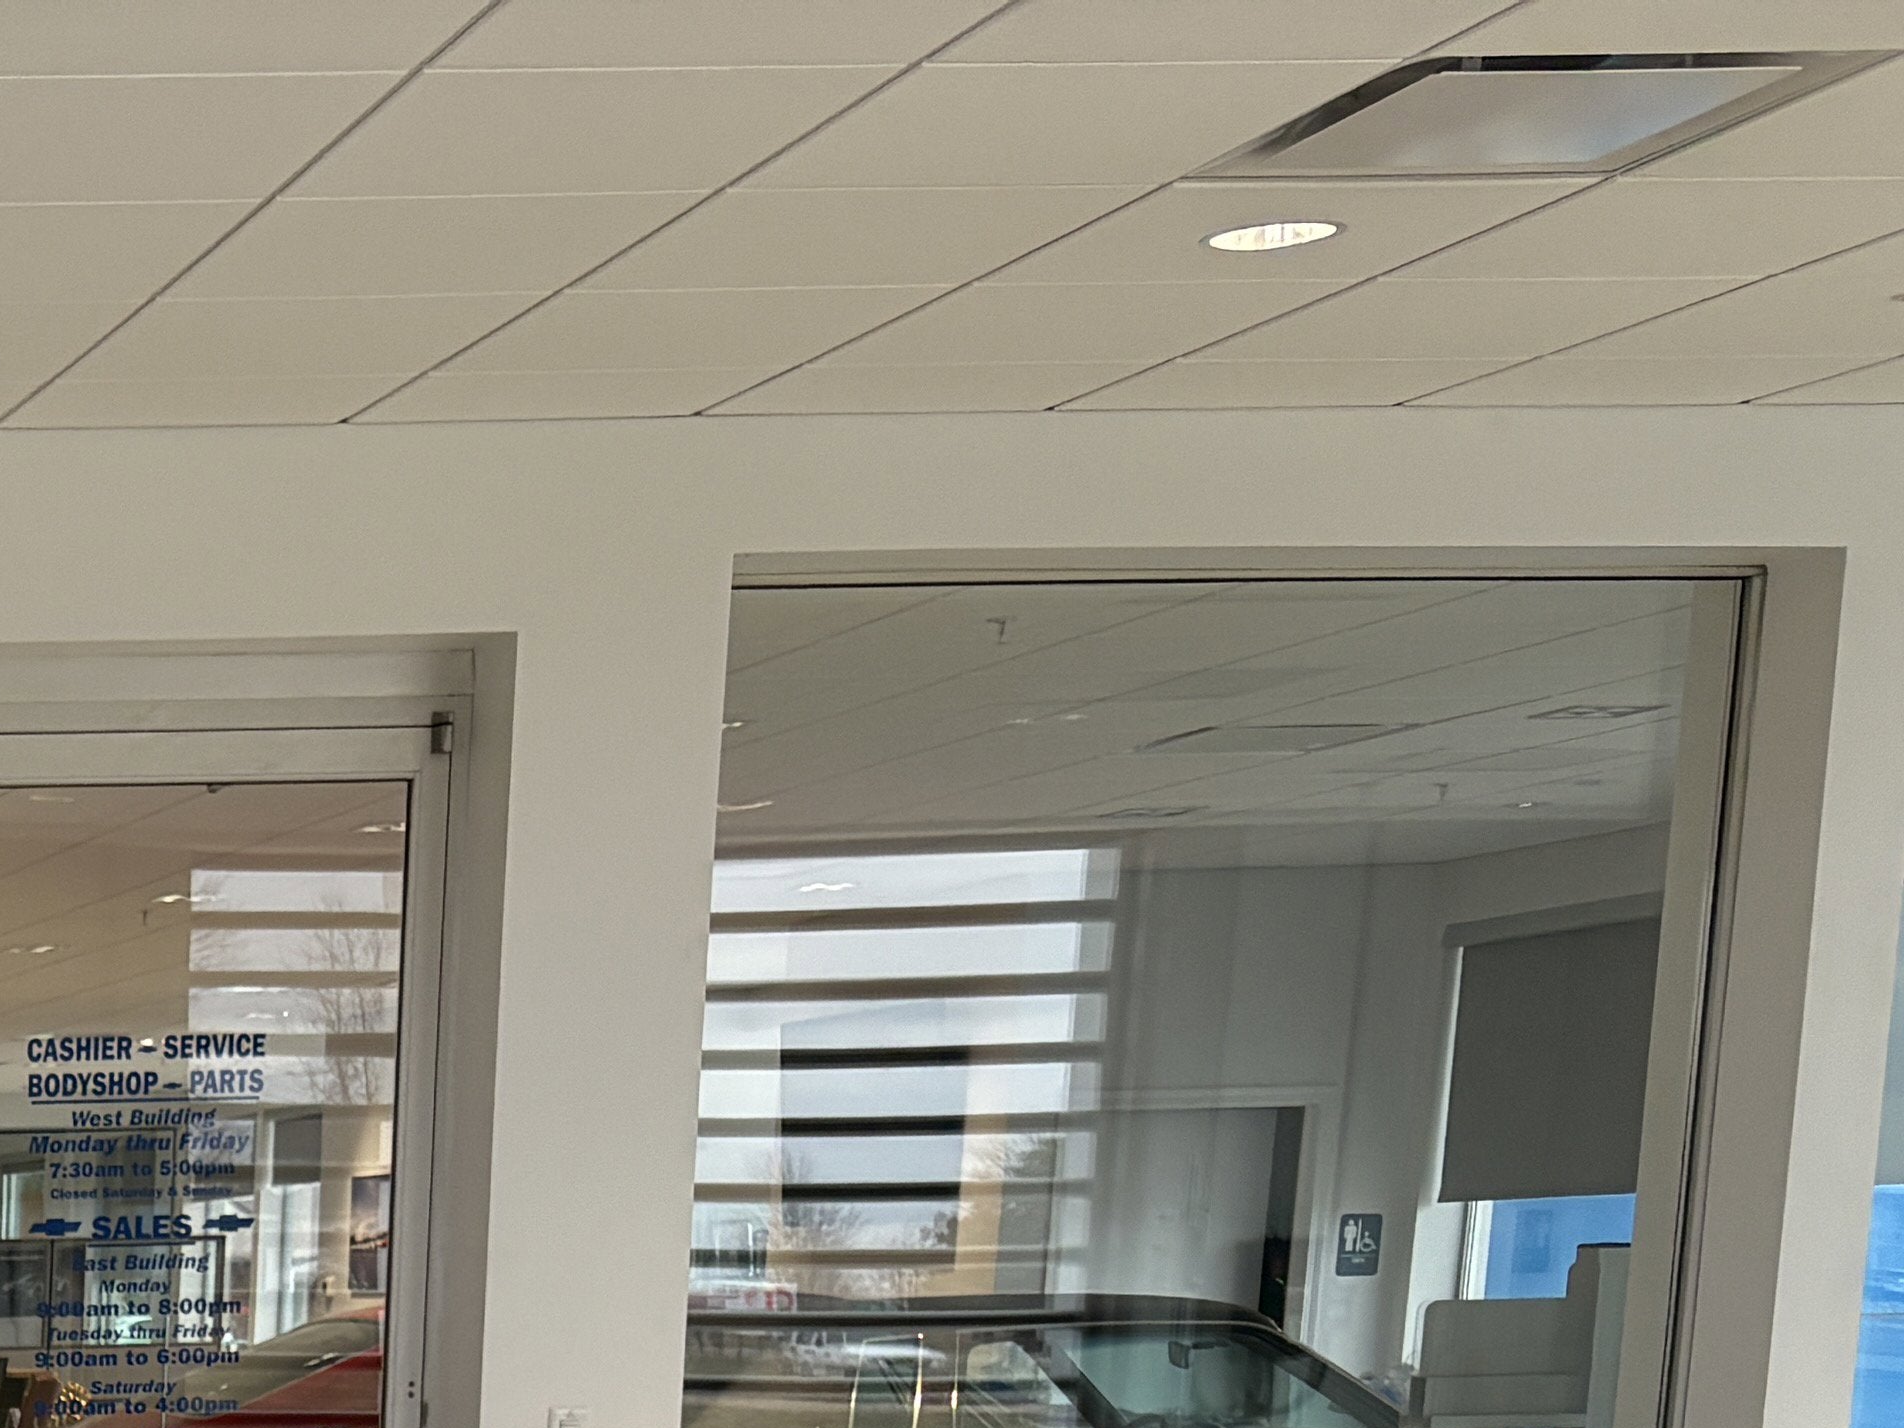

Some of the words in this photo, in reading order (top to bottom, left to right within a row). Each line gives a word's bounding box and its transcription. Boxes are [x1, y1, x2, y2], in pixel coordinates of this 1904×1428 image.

[27, 1036, 132, 1062] CASHIER
[163, 1034, 266, 1060] SERVICE
[28, 1071, 158, 1097] BODYSHOP
[190, 1069, 264, 1094] PARTS
[72, 1110, 122, 1127] West
[130, 1108, 217, 1128] Building
[29, 1136, 118, 1155] Monday
[126, 1134, 171, 1150] thru
[179, 1132, 249, 1153] Friday
[49, 1162, 124, 1179] 7:30am
[132, 1161, 152, 1176] to
[160, 1159, 235, 1178] 5:00pm
[51, 1187, 97, 1200] Closed
[103, 1186, 162, 1200] Saturday
[92, 1214, 193, 1240] SALES
[72, 1255, 117, 1272] East
[124, 1252, 210, 1273] Building
[99, 1279, 172, 1295] Monday
[128, 1300, 150, 1315] to
[158, 1298, 241, 1317] 8:00pm
[49, 1326, 123, 1343] Tuesday
[129, 1324, 166, 1339] thru
[172, 1323, 230, 1340] Friday
[34, 1351, 118, 1368] 9:00am
[126, 1350, 148, 1366] to
[156, 1348, 240, 1366] 6:00pm
[91, 1380, 176, 1396] Saturday
[125, 1399, 147, 1415] to
[155, 1397, 239, 1415] 4:00pm
